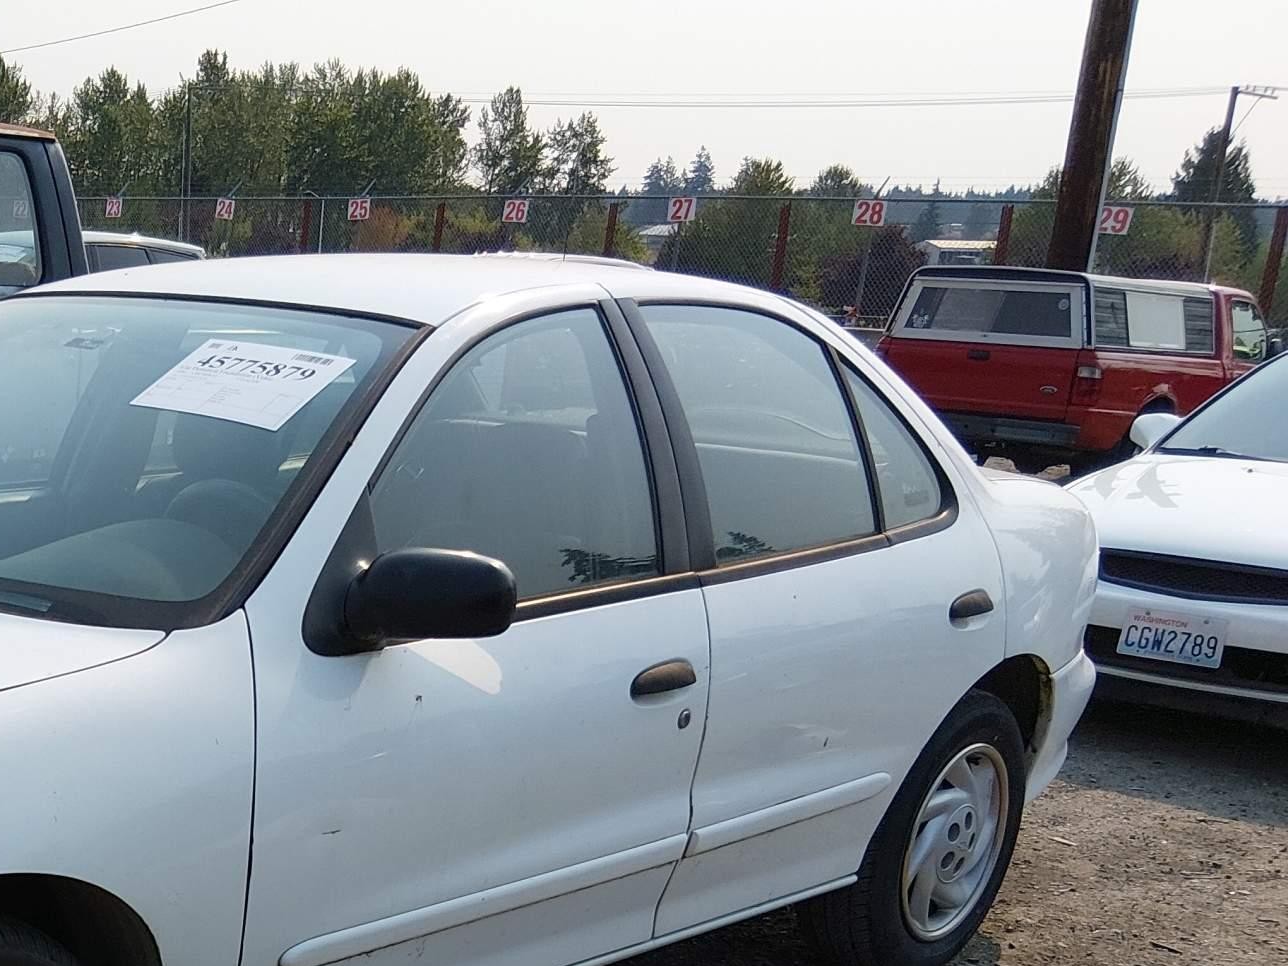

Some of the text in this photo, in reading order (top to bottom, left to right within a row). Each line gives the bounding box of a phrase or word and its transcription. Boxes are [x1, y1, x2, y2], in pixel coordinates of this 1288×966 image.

[107, 200, 121, 217] 23
[217, 201, 233, 218] 24
[350, 201, 368, 219] 25
[504, 202, 525, 221] 26
[671, 199, 693, 220] 27
[856, 202, 884, 225] 28
[1099, 208, 1129, 232] 29
[197, 355, 316, 380] 45775879
[1133, 615, 1188, 628] WASHINGTON
[1124, 625, 1218, 659] CGW2789
